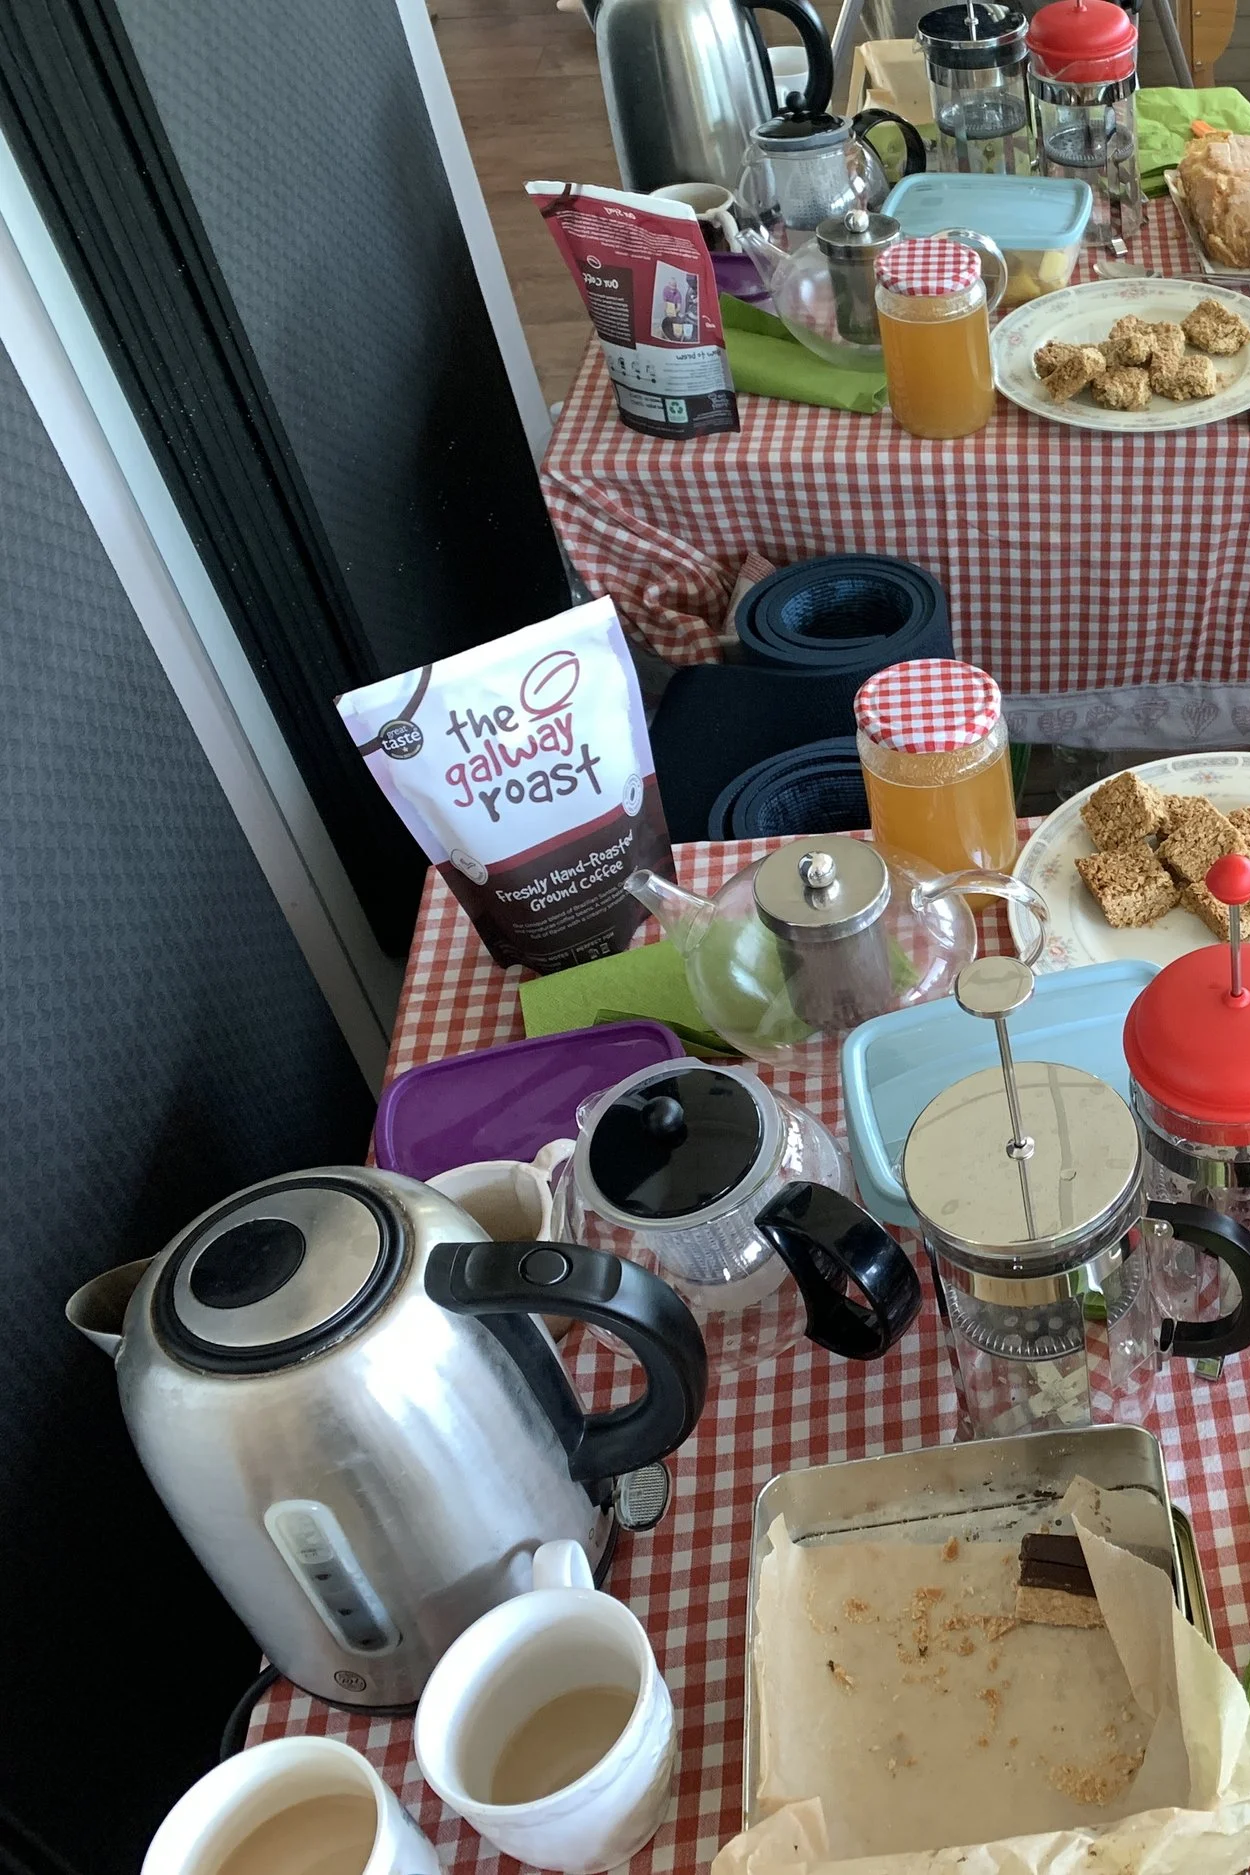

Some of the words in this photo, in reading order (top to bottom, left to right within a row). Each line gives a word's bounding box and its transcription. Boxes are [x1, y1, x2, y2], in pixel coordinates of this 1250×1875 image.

[381, 731, 421, 751] taste
[386, 725, 408, 740] great
[445, 705, 519, 754] the
[445, 712, 574, 808] galway
[478, 743, 602, 823] roast
[495, 878, 547, 903] Freshly
[549, 828, 634, 886] Hand-Roasted
[530, 882, 578, 912] Ground
[580, 860, 624, 889] Coffee
